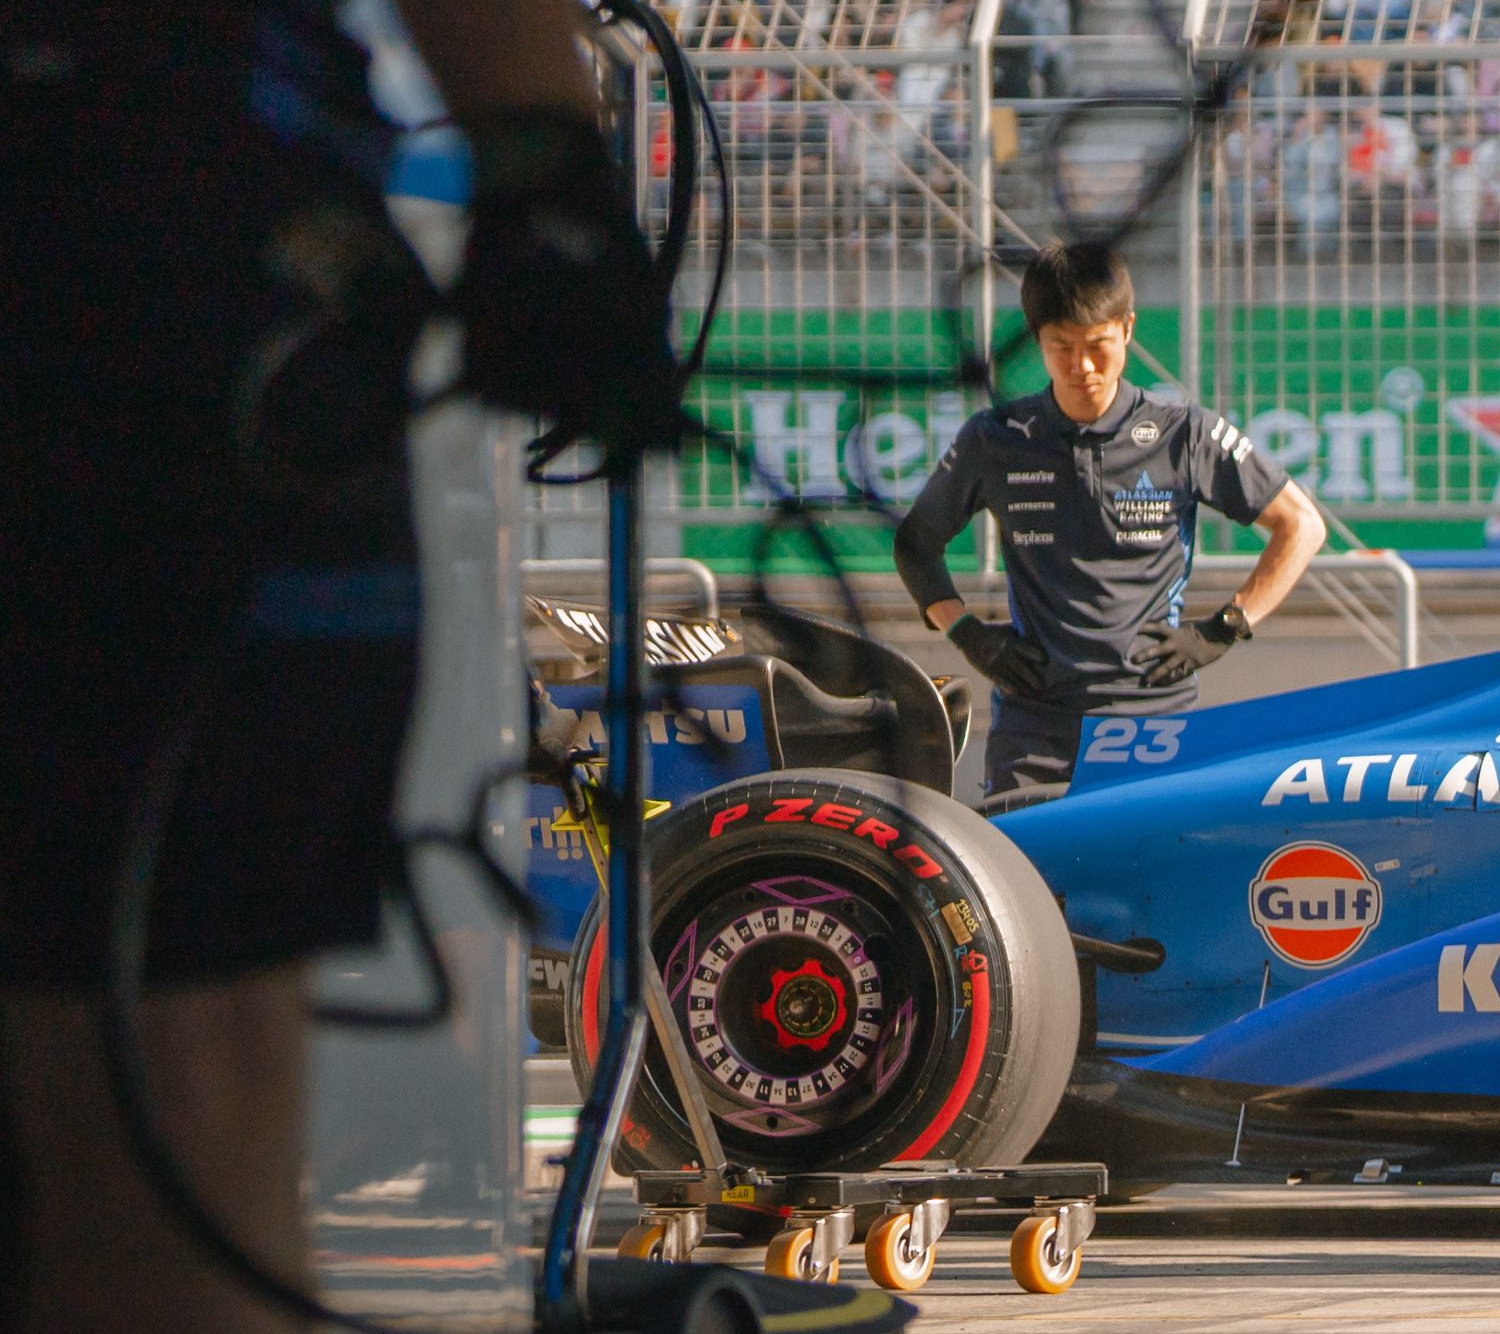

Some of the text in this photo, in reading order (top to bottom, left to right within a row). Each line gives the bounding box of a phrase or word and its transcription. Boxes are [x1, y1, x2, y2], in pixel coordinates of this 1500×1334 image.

[1007, 471, 1055, 484] KOMATSU
[1113, 489, 1173, 501] ATLASSIAN
[1113, 500, 1170, 512] WILLIAMS
[1118, 511, 1163, 524] RACING
[1084, 718, 1187, 764] 23
[709, 797, 944, 879] P ZERO
[1257, 885, 1373, 921] Gulf
[725, 1187, 750, 1200] REAR
